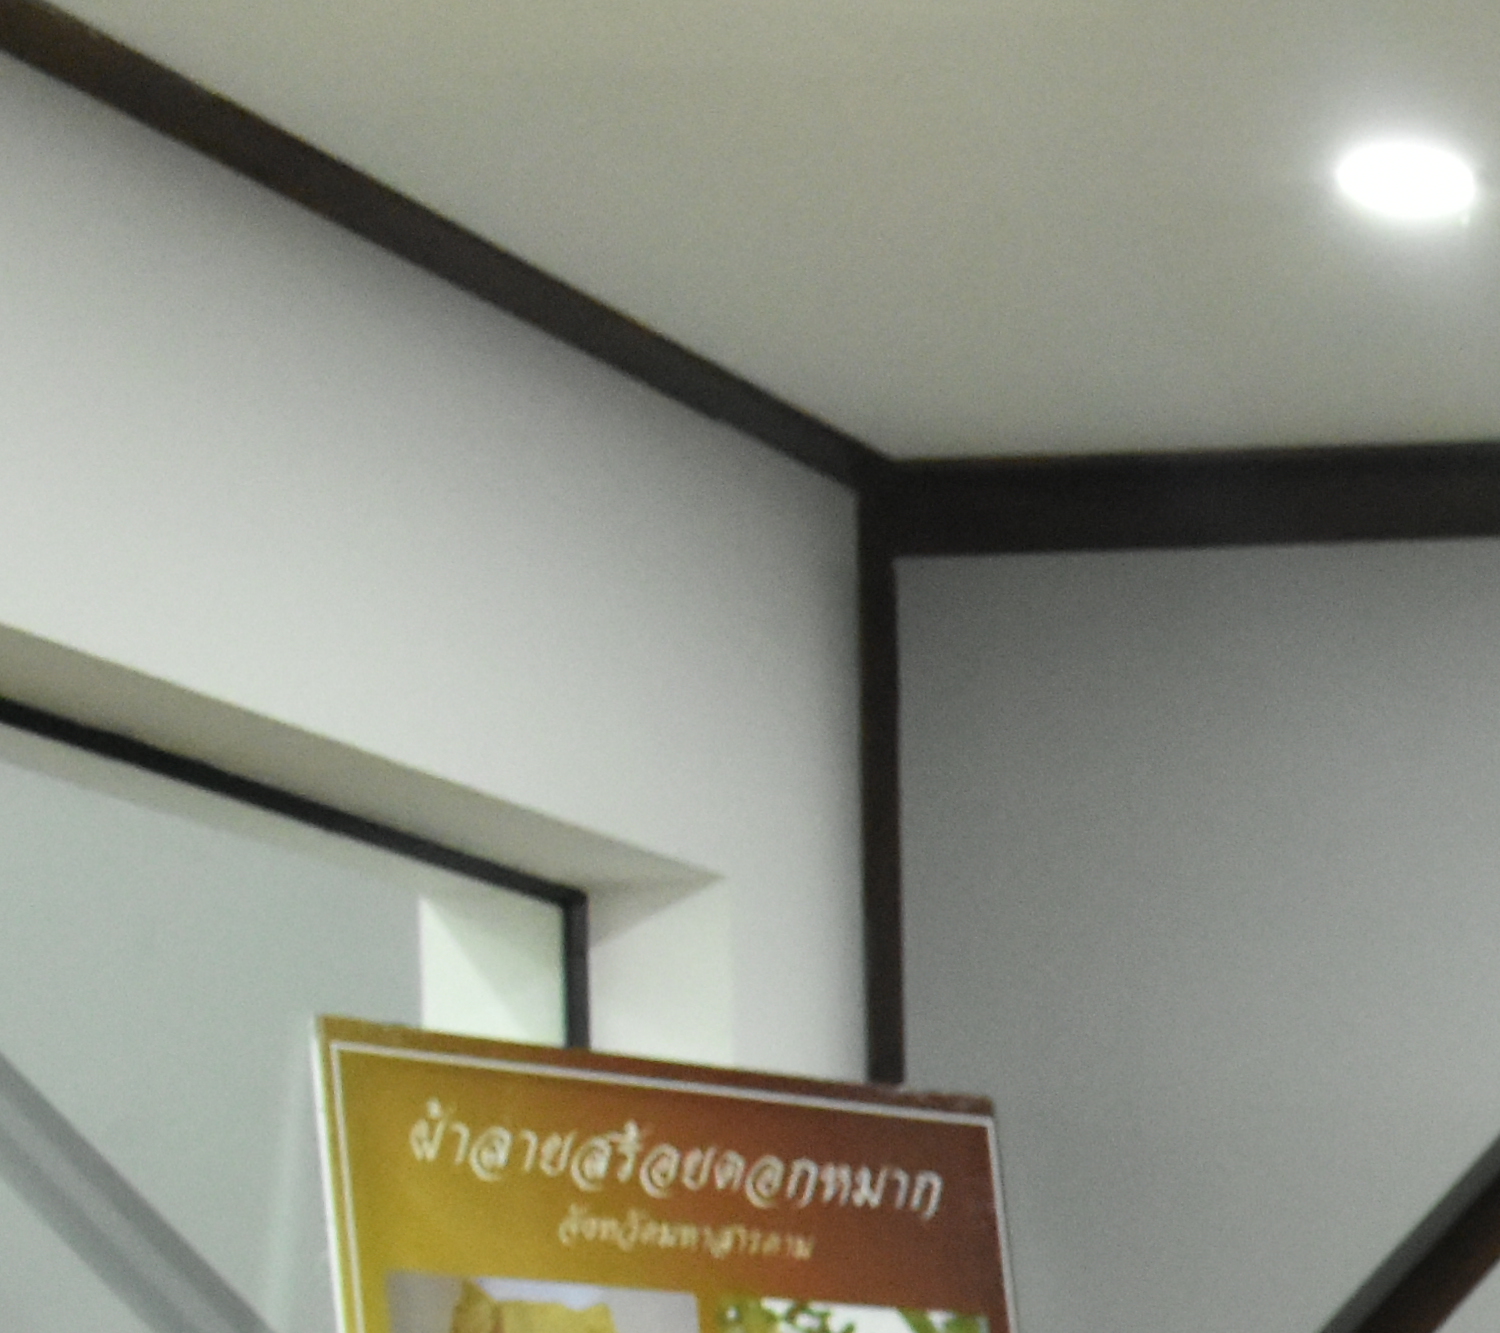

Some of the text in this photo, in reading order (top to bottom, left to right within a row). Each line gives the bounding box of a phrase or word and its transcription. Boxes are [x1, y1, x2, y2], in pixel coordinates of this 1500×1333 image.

[408, 1098, 943, 1220] ผ้าลายสร้อยดอกหมาก
